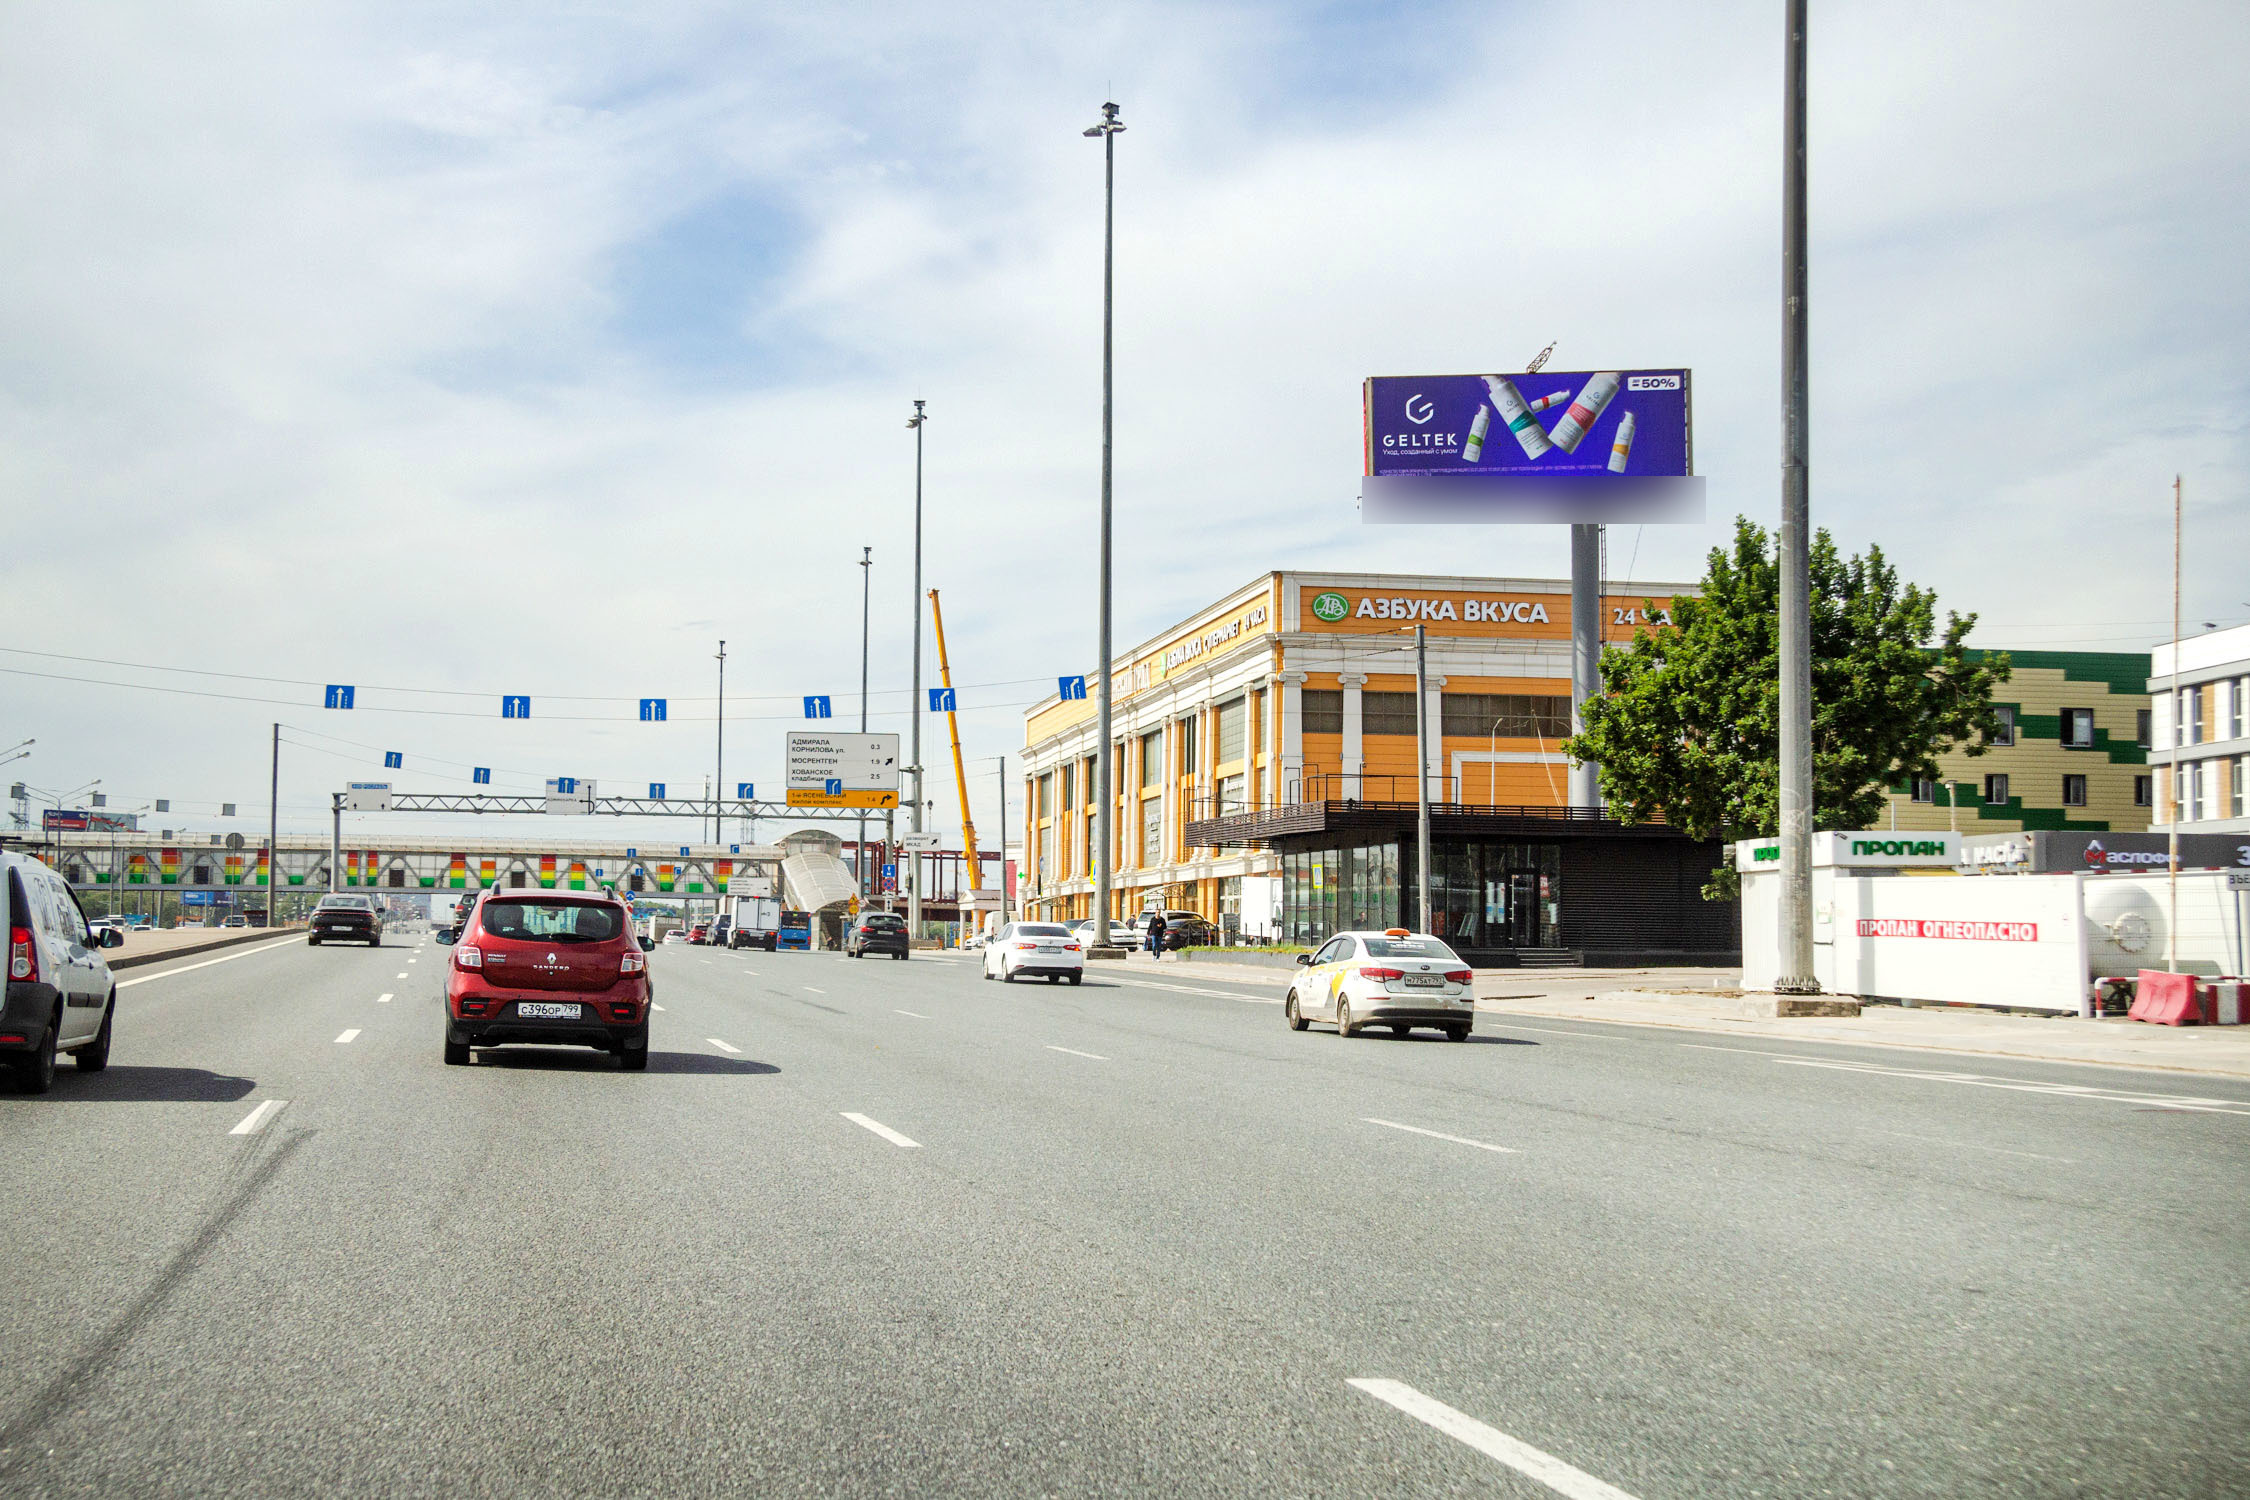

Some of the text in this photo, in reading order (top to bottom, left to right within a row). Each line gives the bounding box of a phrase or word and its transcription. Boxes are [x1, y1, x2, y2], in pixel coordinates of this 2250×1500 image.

[1383, 433, 1458, 447] GELTEK
[1355, 597, 1550, 624] АЗБУКА ВКУСА
[1613, 608, 1636, 625] 24
[792, 738, 830, 746] АДМИРАЛА
[1754, 846, 1780, 861] ПРОП
[1851, 839, 1945, 856] ПРОПАН
[1858, 920, 2033, 941] ПРОПАН ОГНЕОПАСНО
